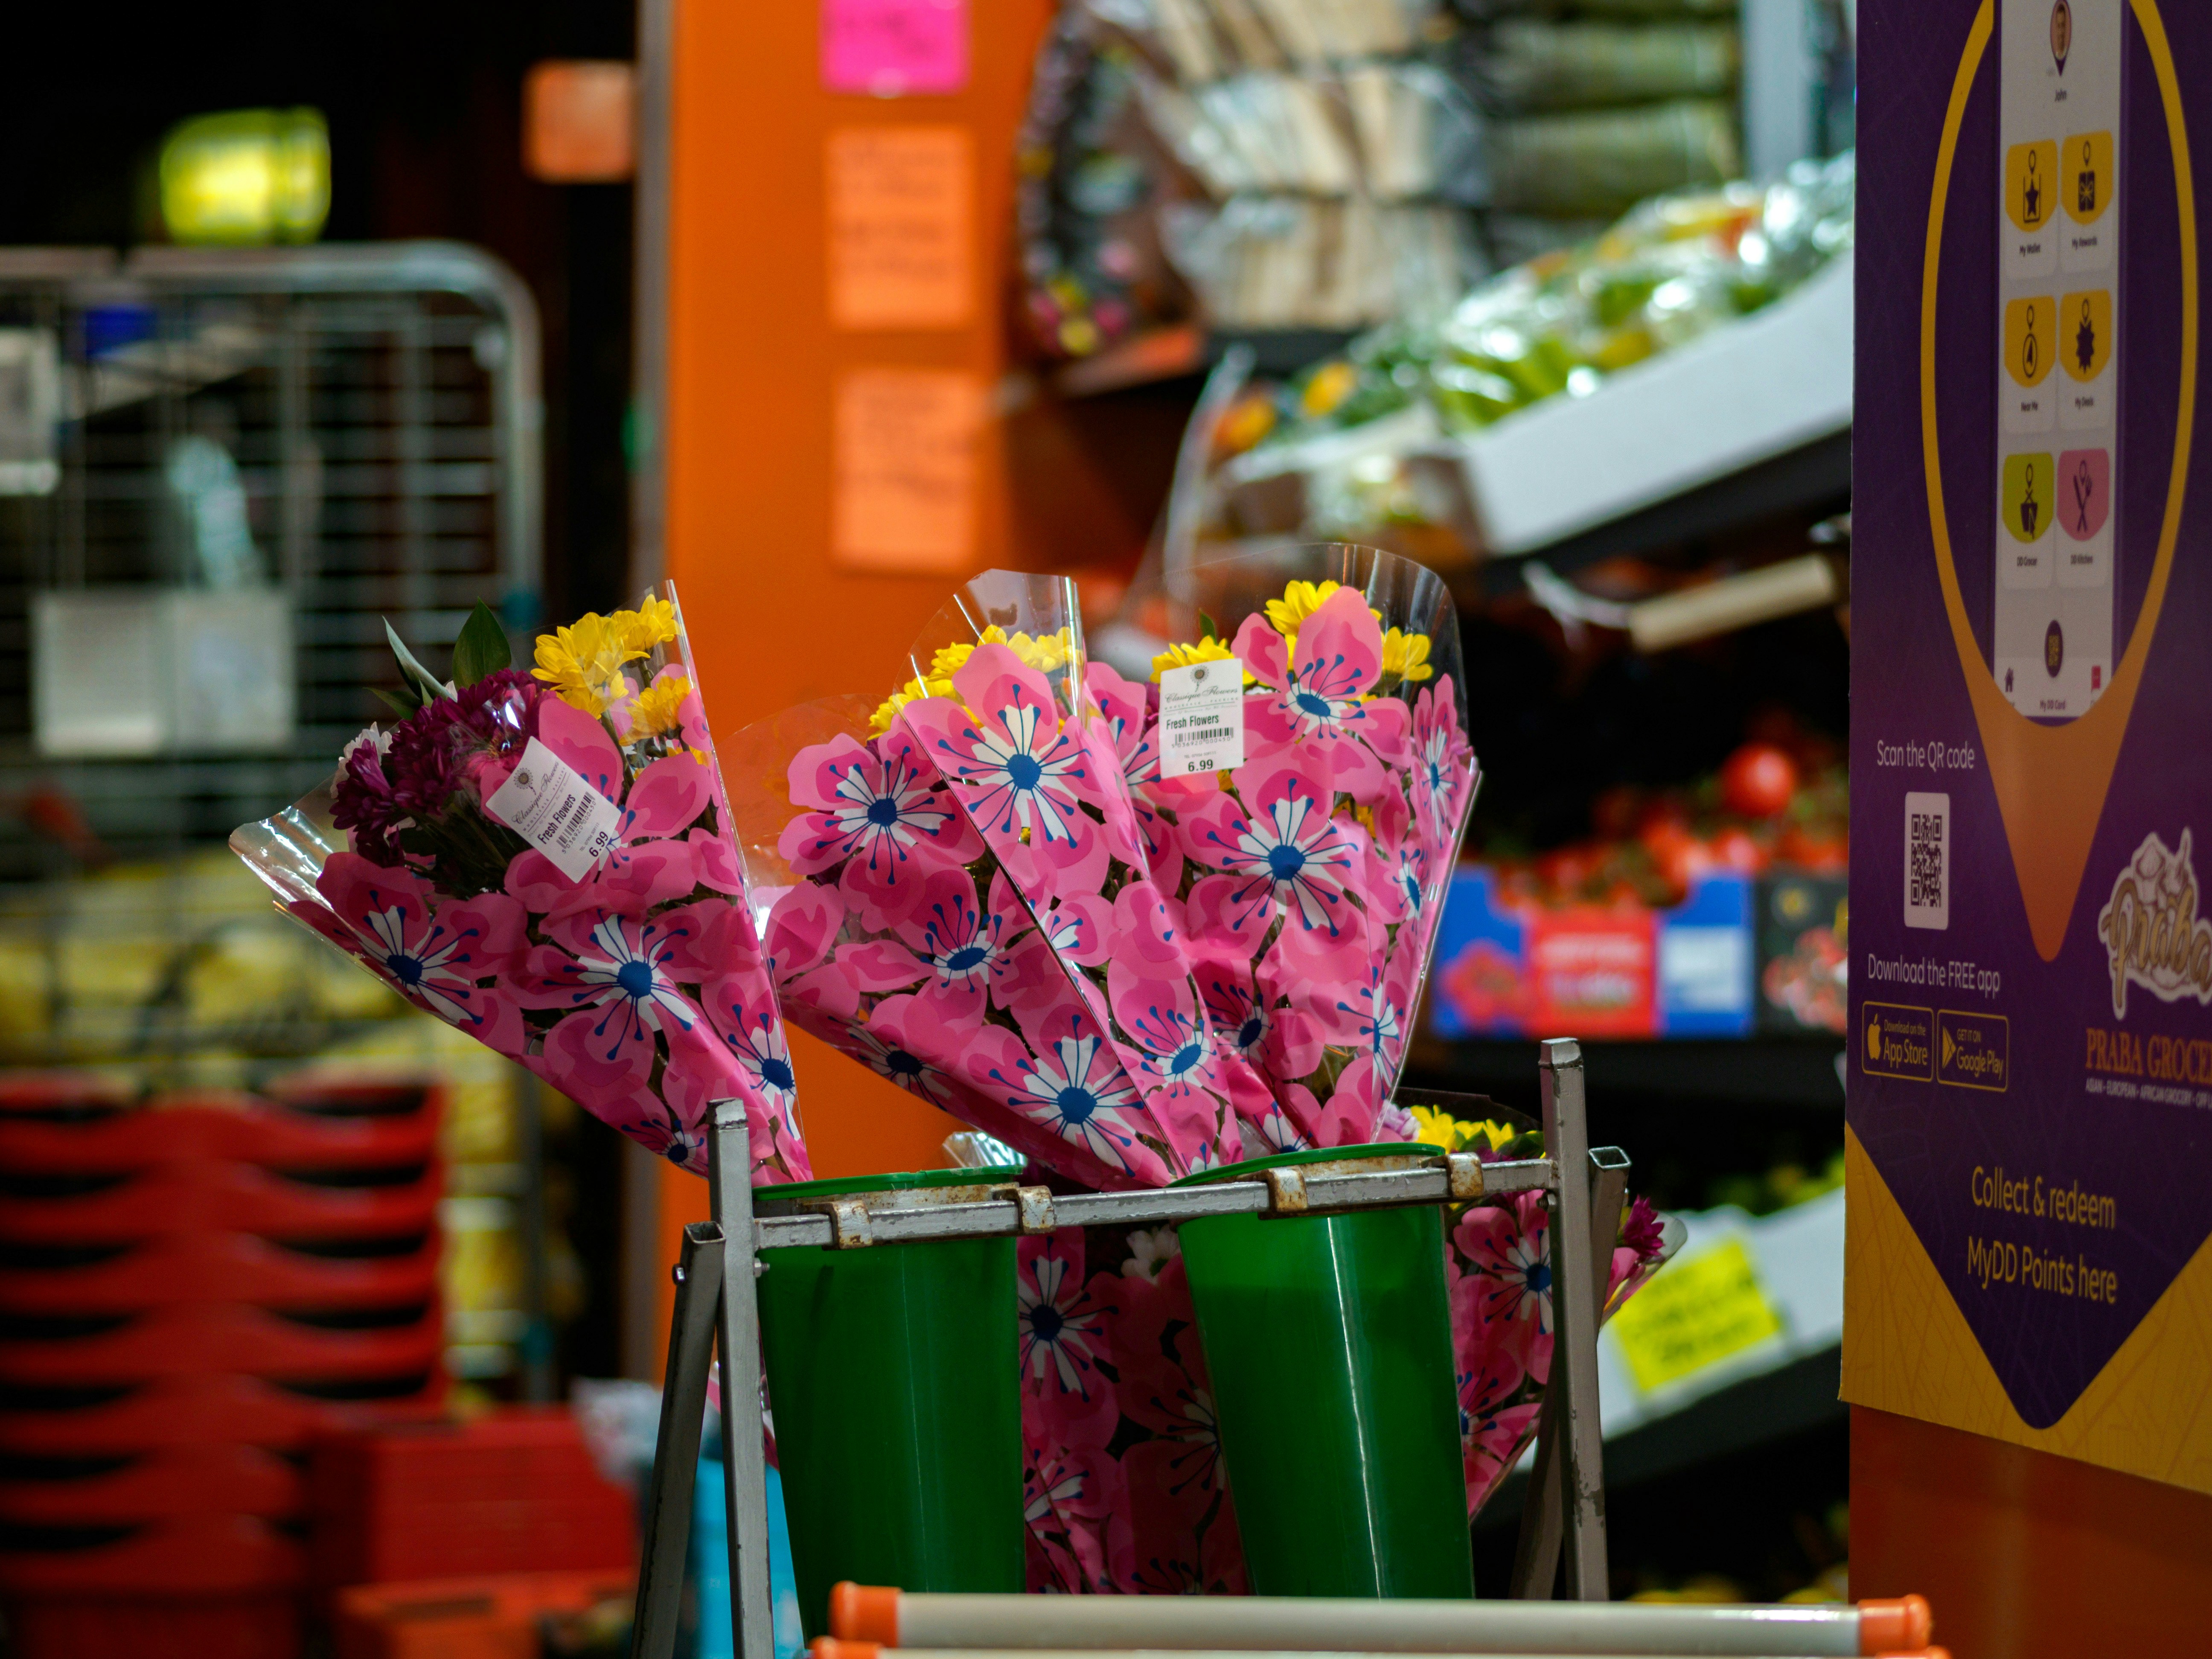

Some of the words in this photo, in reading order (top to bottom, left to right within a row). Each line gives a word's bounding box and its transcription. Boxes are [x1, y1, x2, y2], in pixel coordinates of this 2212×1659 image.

[2055, 89, 2067, 102] John
[2020, 245, 2026, 257] My
[2026, 243, 2040, 254] Wallet
[2072, 238, 2078, 250] My
[2021, 402, 2031, 411] Near
[2032, 401, 2038, 410] Me
[2017, 556, 2023, 566] DD
[2070, 555, 2077, 565] DD
[2077, 554, 2093, 564] Kitchen
[1165, 693, 1201, 703] Classique
[1202, 685, 1237, 696] Flowers
[2040, 700, 2046, 712] My
[2047, 700, 2054, 710] DD
[2055, 700, 2066, 710] Card
[1166, 717, 1187, 730] Fresh
[1190, 715, 1219, 727] Flowers
[1877, 739, 1903, 766] Scan
[1906, 739, 1925, 767] the
[1928, 741, 1944, 772] QR
[1947, 740, 1974, 769] code
[1188, 759, 1213, 772] 6.99
[512, 792, 543, 824] Classique
[541, 761, 559, 792] Flowers
[537, 822, 559, 844] Fresh
[553, 794, 576, 824] Flowers
[589, 831, 608, 857] 6.99
[1869, 953, 1925, 986] Download
[1927, 958, 1945, 987] the
[1948, 961, 1976, 990] FREE
[1978, 970, 2000, 999] app
[1884, 1019, 1909, 1034] Download
[1910, 1025, 1917, 1035] on
[1917, 1023, 1926, 1036] the
[1957, 1028, 1967, 1041] GET
[1968, 1030, 1972, 1042] IT
[1973, 1030, 1981, 1042] ON
[1883, 1036, 1903, 1068] App
[1903, 1039, 1927, 1066] Store
[2086, 1027, 2144, 1076] PRABA
[1956, 1046, 1986, 1077] Google
[1987, 1050, 2004, 1081] Play
[2086, 1077, 2103, 1093] ASIAN
[2107, 1080, 2136, 1098] EUROPEAN
[2140, 1085, 2164, 1102] AFRICAN
[2164, 1087, 2192, 1106] GROCERY
[1972, 1166, 2029, 1215] Collect
[2033, 1176, 2045, 1217] &
[2049, 1179, 2115, 1229] redeem
[1968, 1235, 2017, 1290] MyDD
[2022, 1246, 2075, 1295] Points
[2078, 1253, 2118, 1304] here
